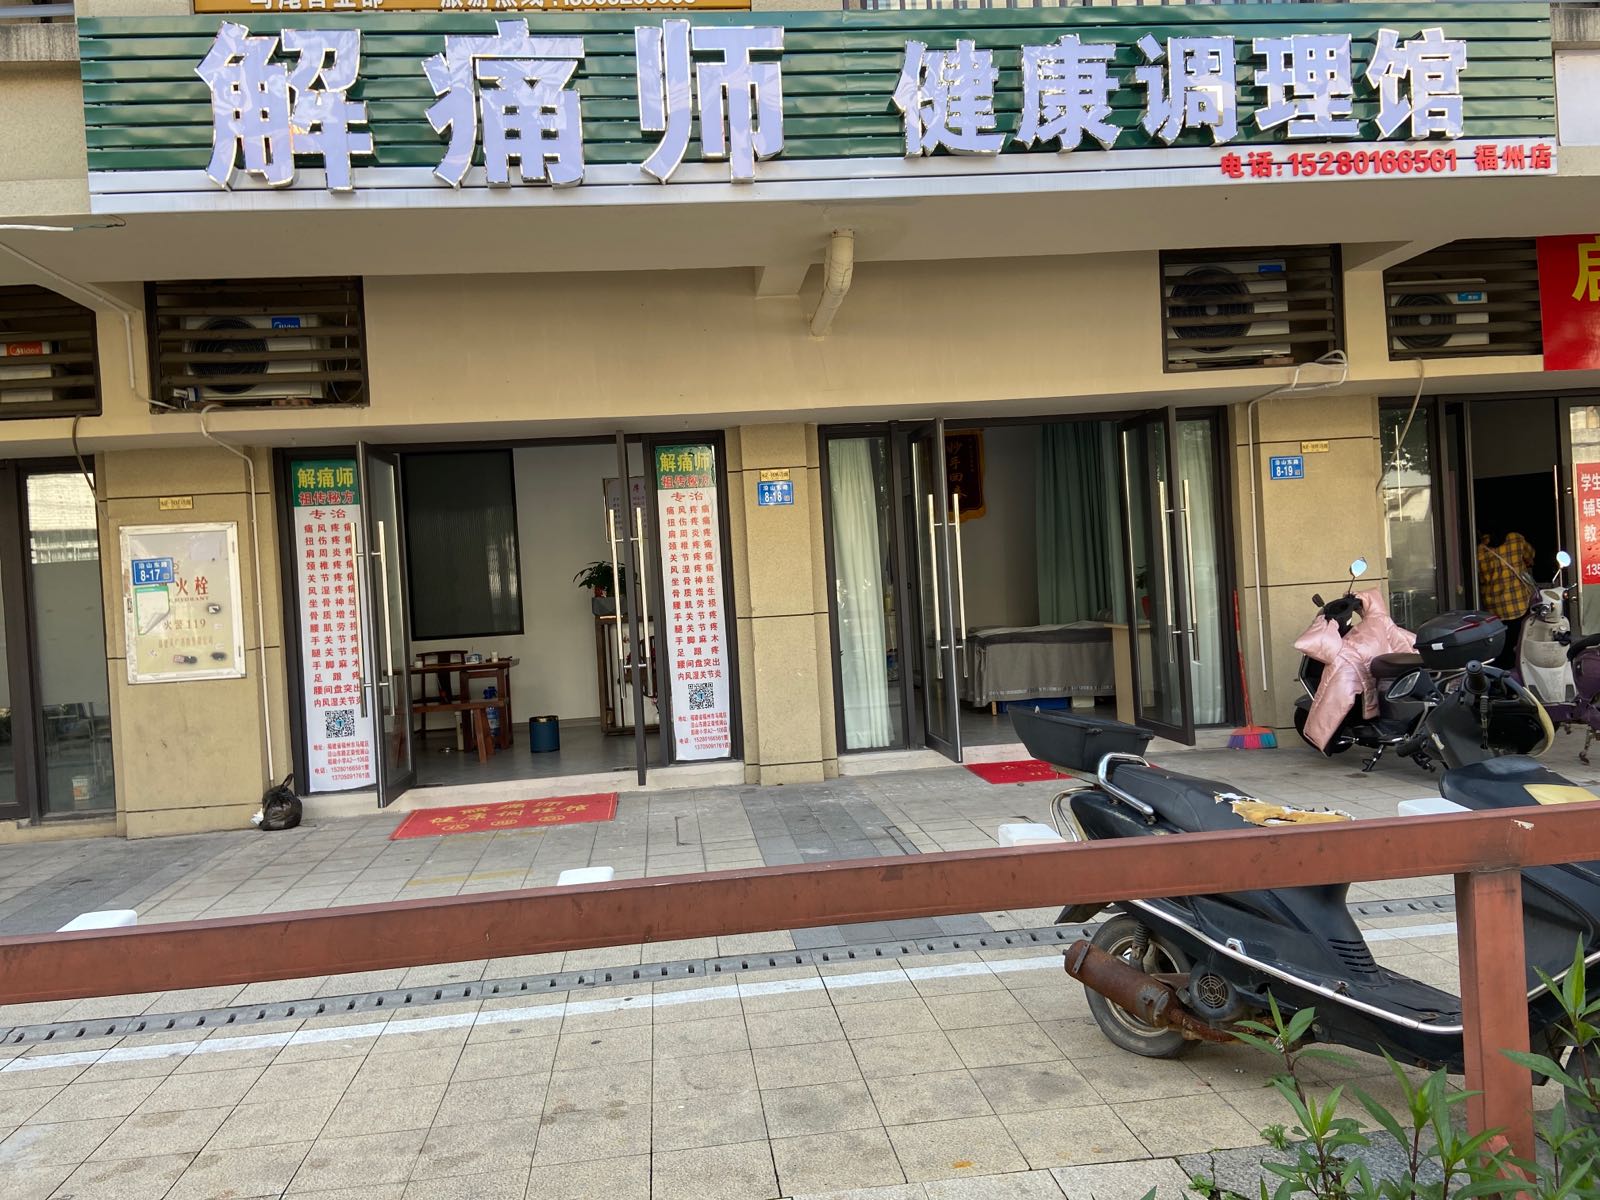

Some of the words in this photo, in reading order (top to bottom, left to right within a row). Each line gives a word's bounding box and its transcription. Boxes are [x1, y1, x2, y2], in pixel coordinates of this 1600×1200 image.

[195, 18, 785, 192] 解痛师
[892, 26, 1468, 158] 健康调理馆
[1221, 147, 1457, 178] 电话:15280166561
[1475, 143, 1551, 171] 福州店
[660, 452, 710, 473] 解痛师
[1276, 466, 1293, 476] 8-19
[297, 467, 353, 488] 解痛师
[661, 474, 711, 489] 祖传秘方
[298, 490, 354, 505] 祖传秘方
[671, 491, 704, 502] 专治
[764, 491, 782, 503] 8-18
[309, 509, 346, 519] 专治
[666, 504, 710, 516] 痛风疼痛
[667, 516, 711, 527] 扭伤疼痛
[304, 523, 351, 533] 痛风疼痛
[668, 528, 711, 540] 肩周炎疼
[305, 535, 352, 546] 扭伤疼痛
[668, 539, 712, 551] 颈椎疼痛
[669, 551, 713, 563] 关节疼痛
[306, 560, 353, 571] 颈椎疼痛
[670, 563, 714, 575] 风湿疼痛
[140, 568, 161, 582] 8-17
[307, 572, 354, 583] 关节疼痛
[671, 575, 715, 587] 坐骨神经
[176, 576, 209, 597] 火栓
[308, 585, 355, 595] 风湿疼痛
[672, 587, 716, 599] 骨质增生
[309, 597, 355, 608] 坐骨神经
[672, 598, 717, 610] 腰肌劳损
[310, 609, 356, 621] 骨质增生
[674, 610, 718, 622] 手关节疼
[674, 622, 718, 634] 腿关节疼
[675, 634, 719, 646] 手脚麻木
[677, 646, 719, 657] 足跟疼
[312, 659, 360, 671] 手脚麻木
[676, 658, 721, 669] 腰间盘突出
[678, 669, 722, 681] 内风湿关节炎
[313, 683, 361, 695] 腰间盘突出
